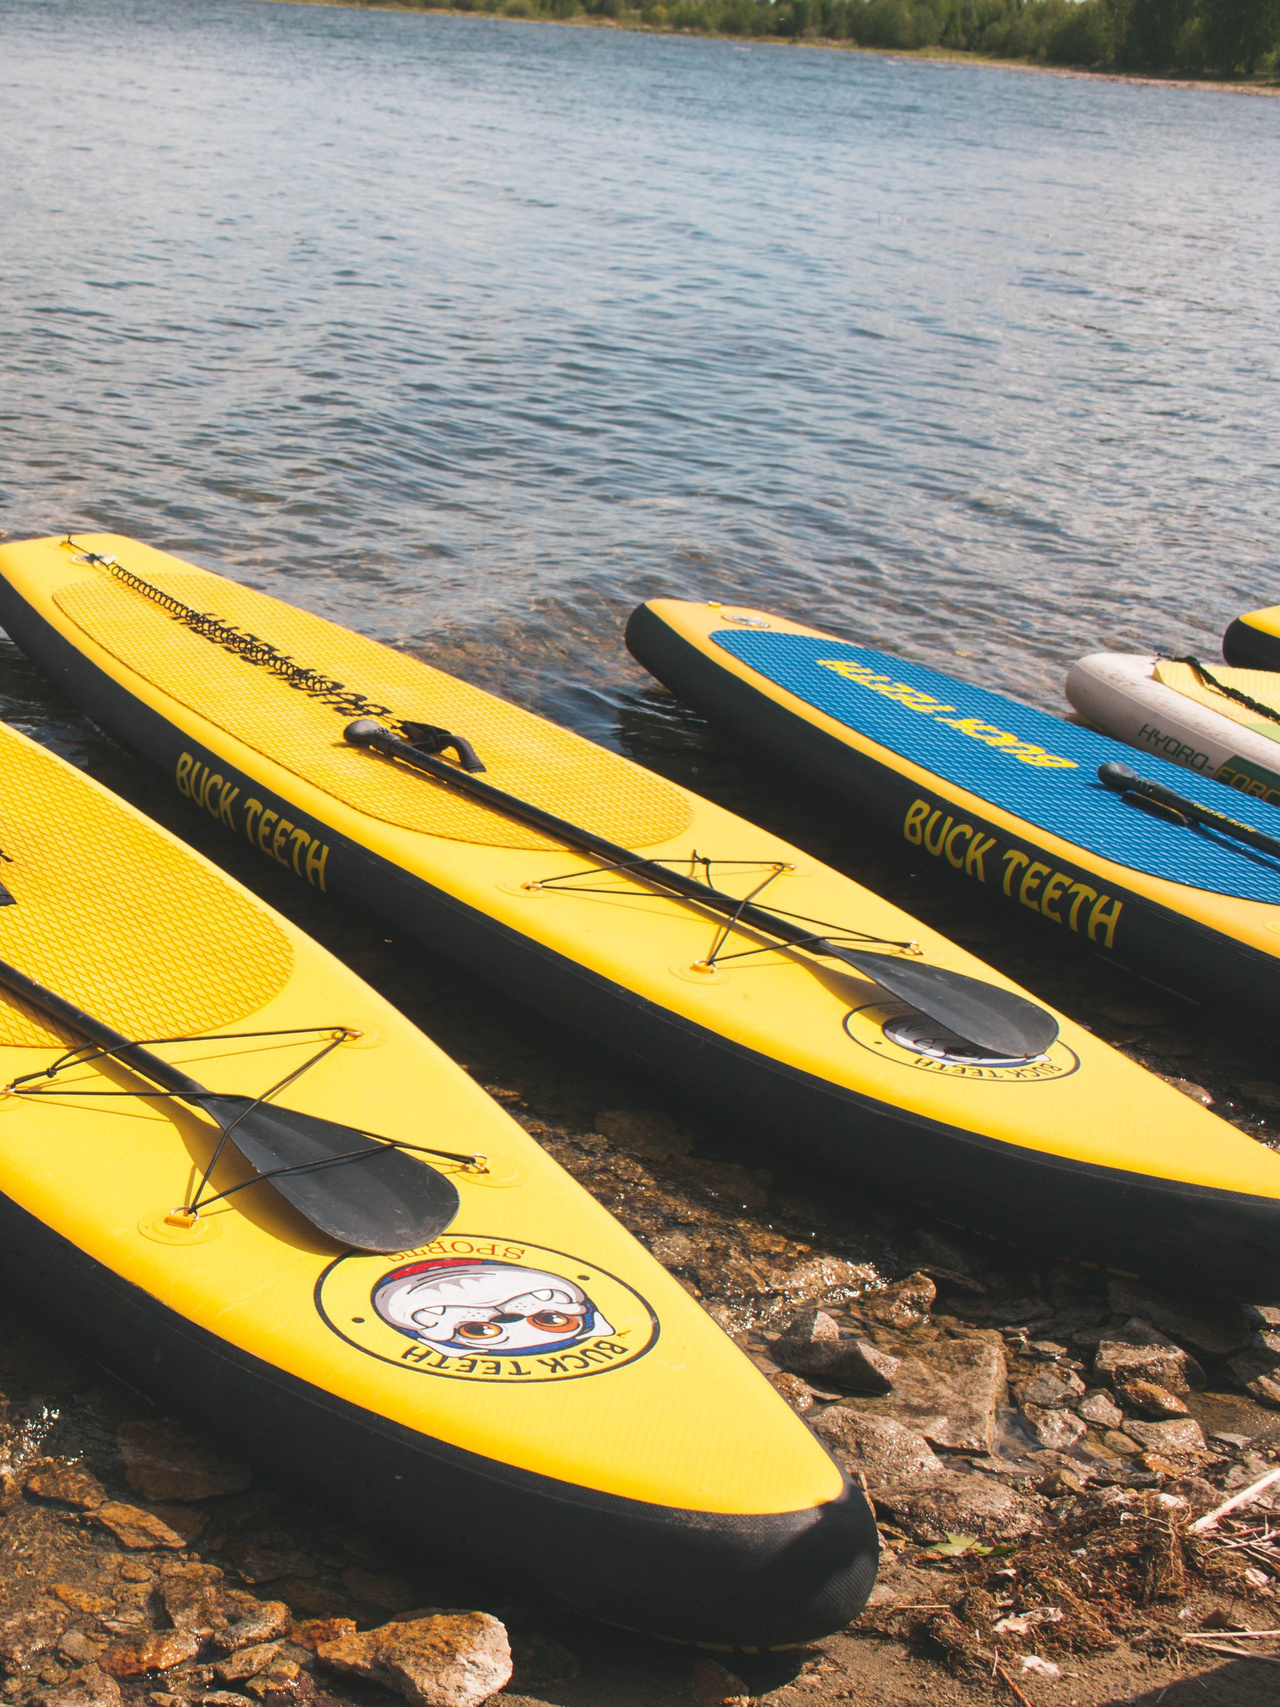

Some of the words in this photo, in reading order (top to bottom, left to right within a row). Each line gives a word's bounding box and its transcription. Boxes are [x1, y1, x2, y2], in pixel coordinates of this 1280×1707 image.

[816, 658, 956, 714] TEETH
[935, 716, 1080, 769] BUCK
[175, 751, 240, 831] BUCK
[243, 797, 330, 892] TEETH
[903, 798, 997, 883] BUCK
[1002, 848, 1123, 949] TEETH
[401, 1345, 532, 1377] TEETH
[537, 1339, 629, 1375] BUCK
